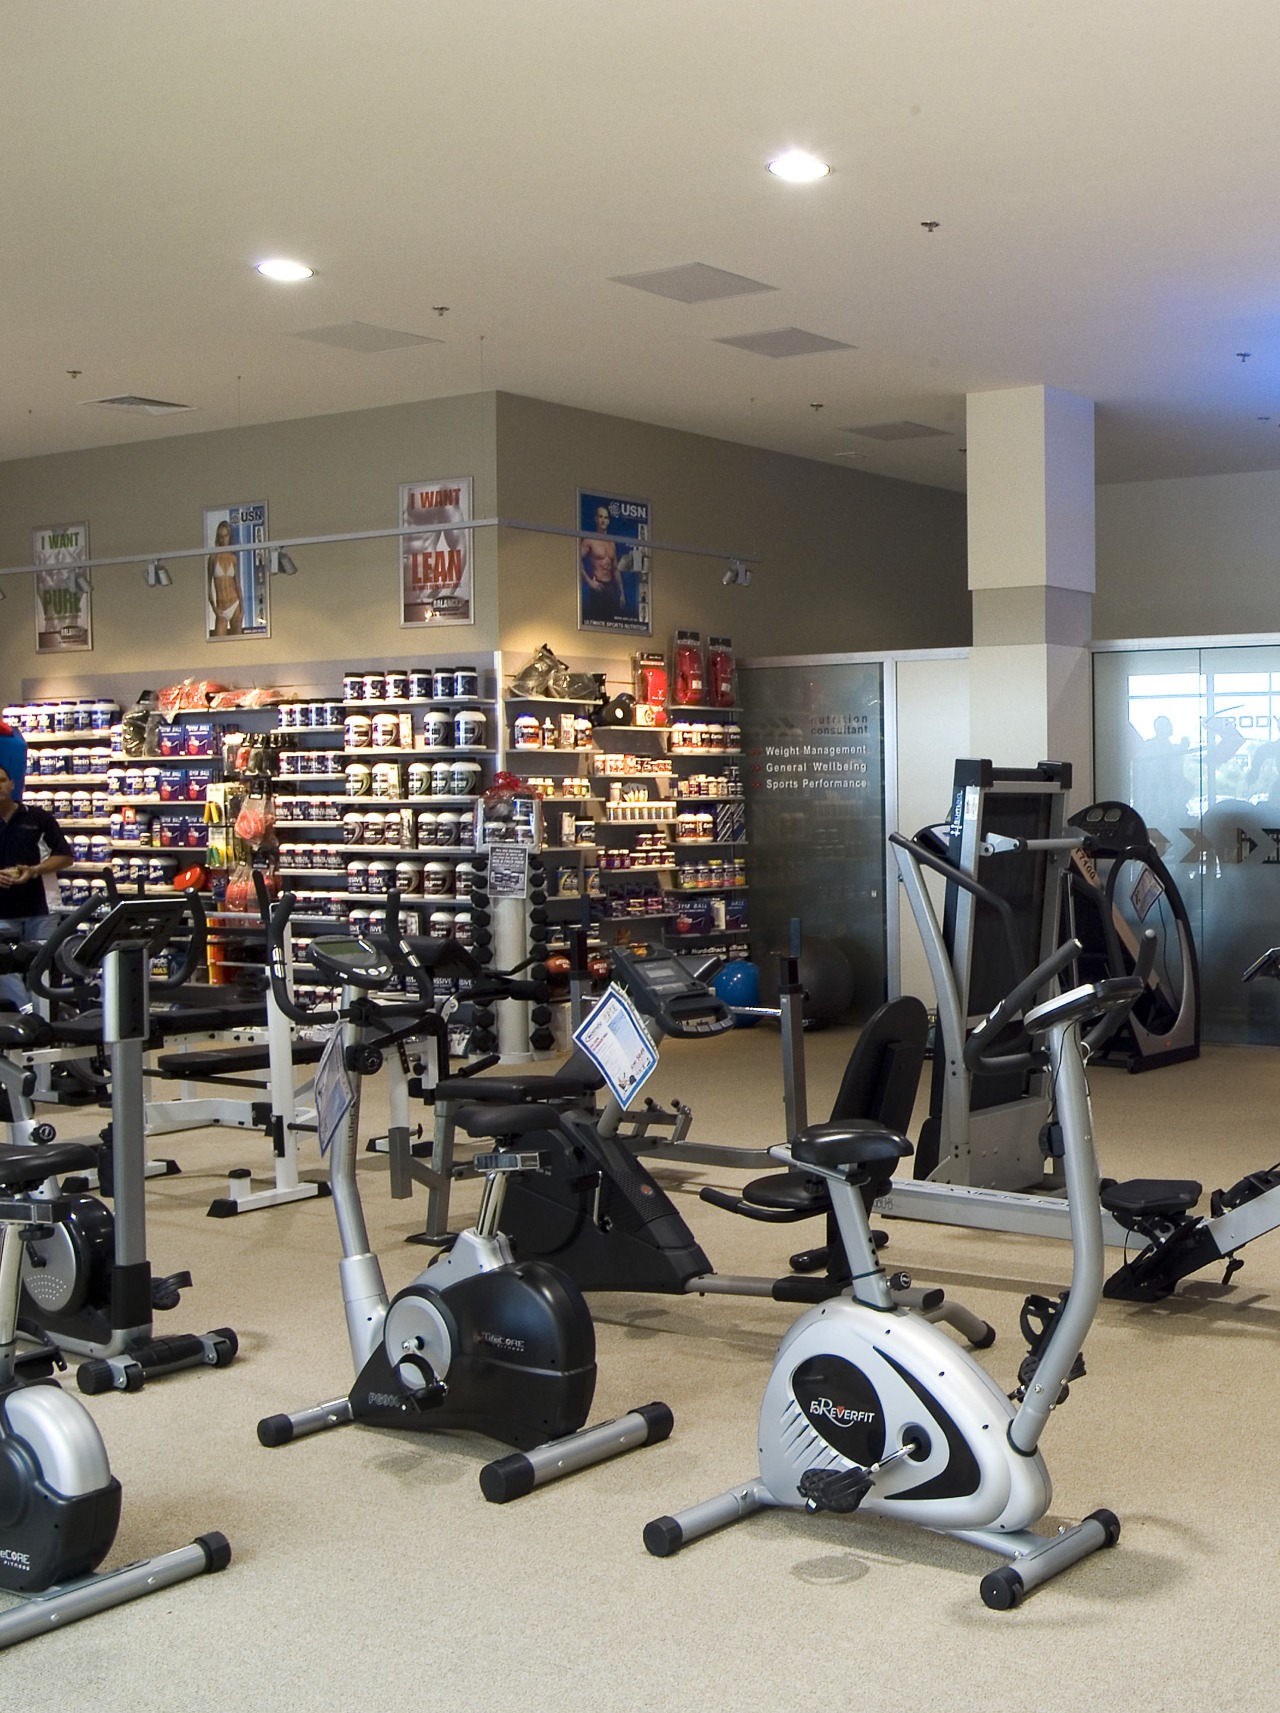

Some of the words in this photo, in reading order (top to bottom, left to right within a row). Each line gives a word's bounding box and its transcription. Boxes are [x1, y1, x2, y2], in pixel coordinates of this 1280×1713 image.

[411, 492, 415, 509] I
[420, 488, 461, 509] WANT
[241, 511, 262, 522] USN
[621, 504, 647, 518] USN
[42, 535, 45, 550] I
[49, 532, 79, 549] WANT
[412, 549, 461, 584] LEAN
[765, 747, 799, 757] Weight
[803, 745, 866, 756] Management
[766, 763, 807, 773] General
[812, 762, 867, 773] Wellbeing
[766, 779, 799, 790] Sports
[802, 777, 867, 789] Performance
